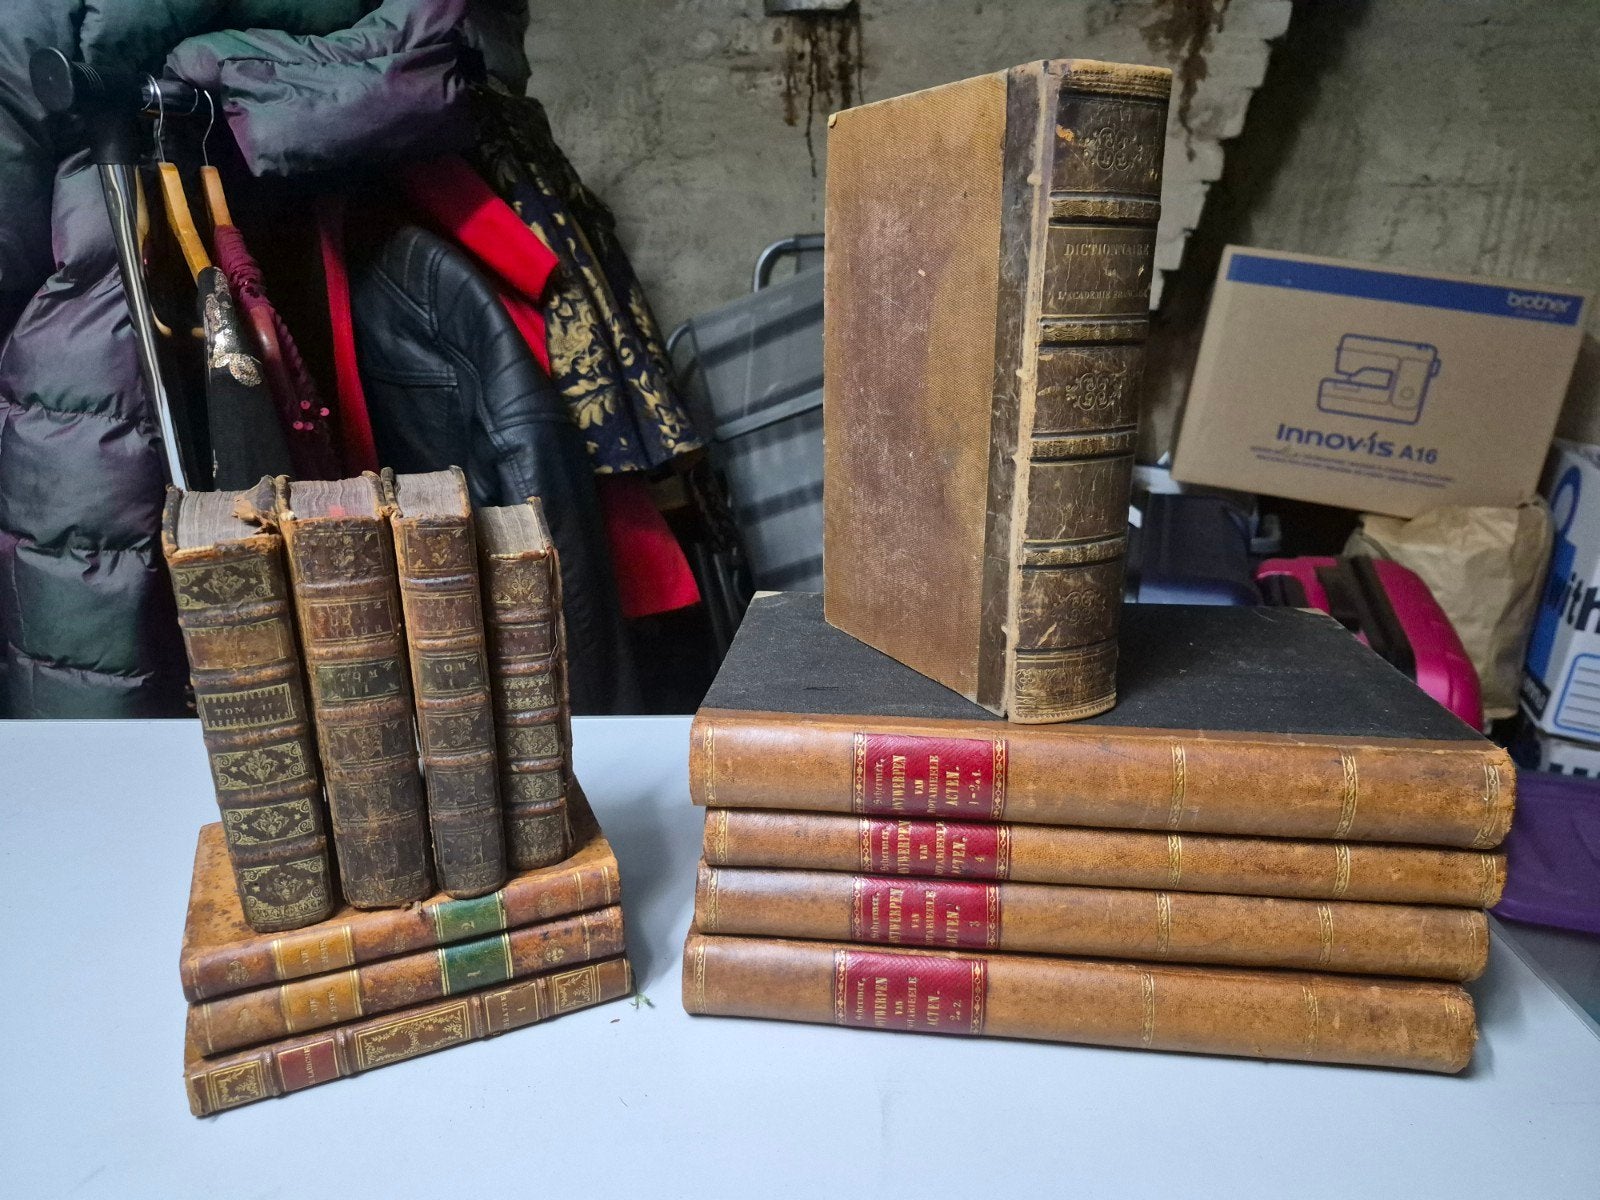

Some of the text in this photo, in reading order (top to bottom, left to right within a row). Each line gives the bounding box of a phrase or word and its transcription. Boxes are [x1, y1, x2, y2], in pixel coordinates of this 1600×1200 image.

[1506, 291, 1572, 313] brother
[1398, 445, 1439, 465] A16
[213, 706, 247, 717] TOM
[914, 779, 924, 795] VAN
[919, 843, 928, 860] VAN
[460, 920, 475, 931] 2
[911, 913, 920, 929] VAN
[467, 969, 481, 978] 1
[894, 1000, 903, 1015] VAN
